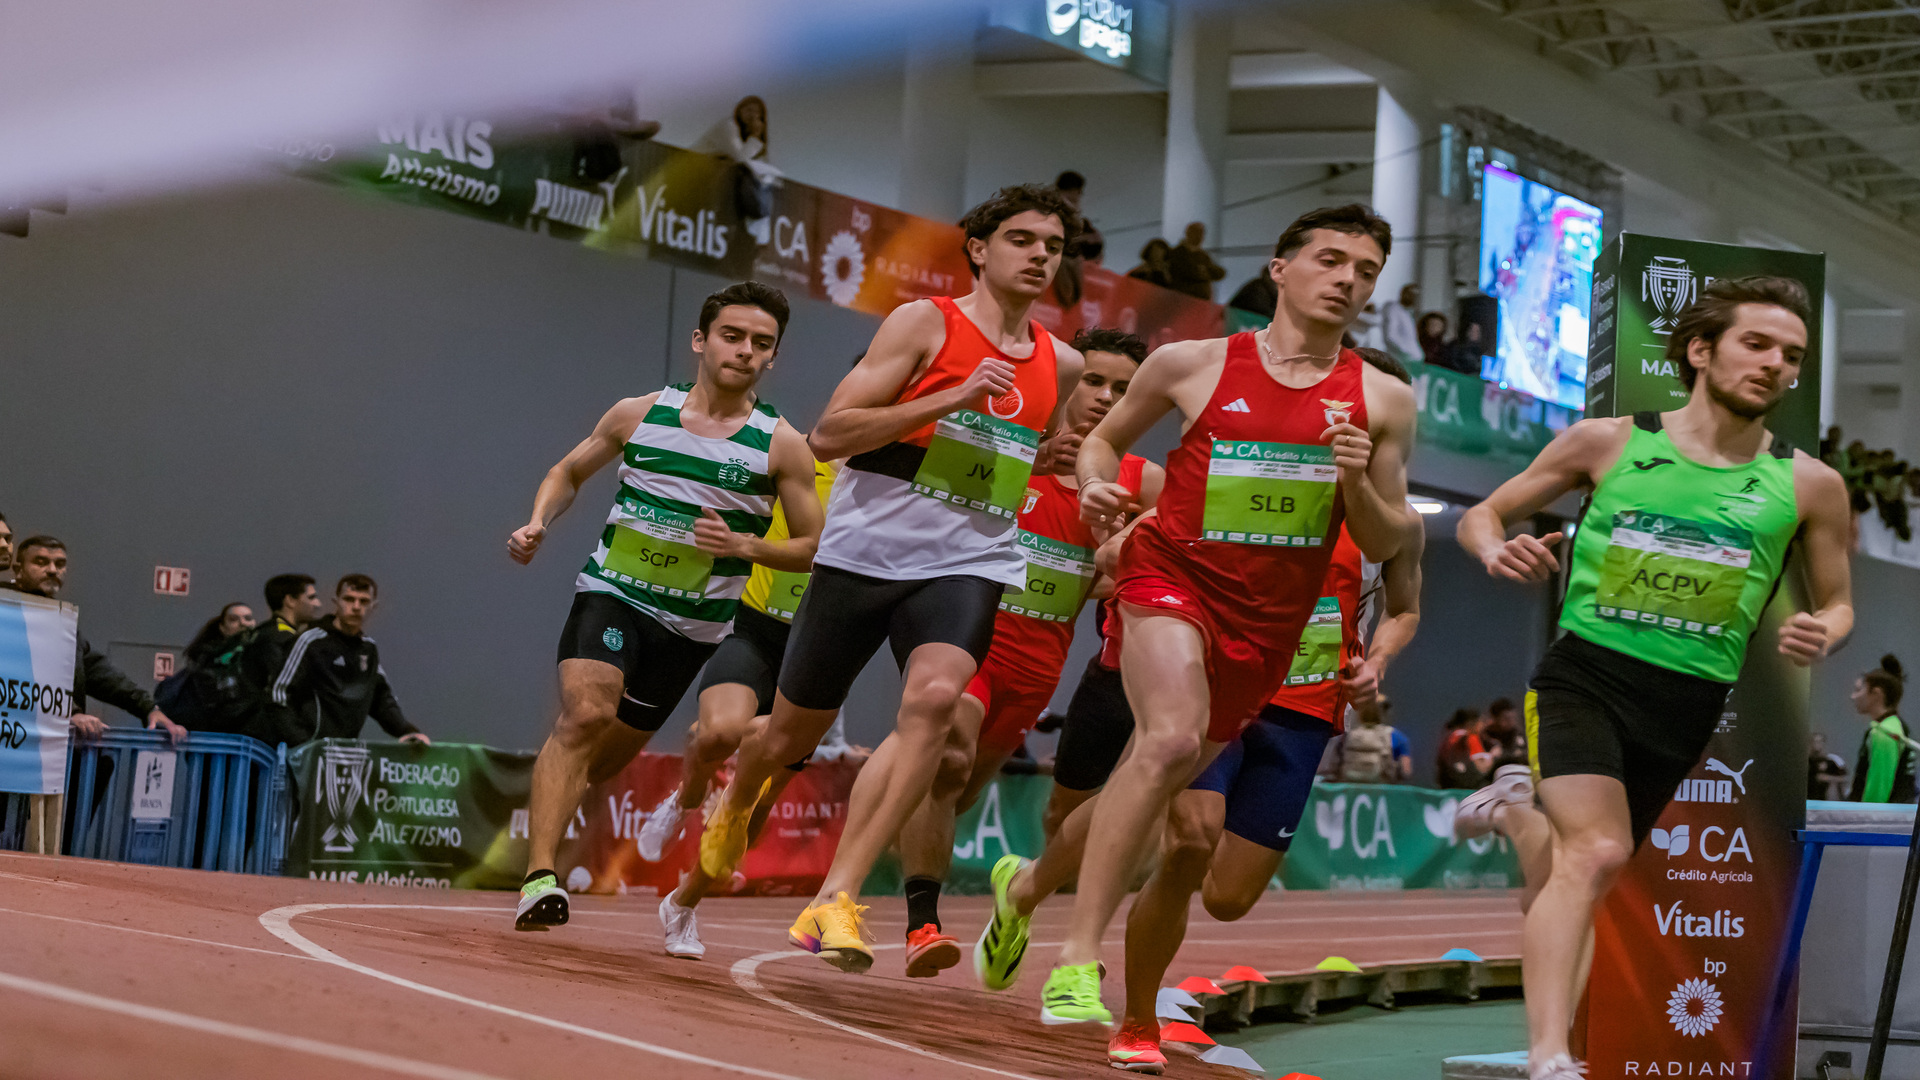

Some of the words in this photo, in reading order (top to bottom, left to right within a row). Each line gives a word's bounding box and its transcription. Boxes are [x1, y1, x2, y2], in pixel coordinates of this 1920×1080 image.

[380, 152, 500, 206] Atletismo
[530, 177, 606, 232] PUMA
[637, 185, 728, 260] Vitalis
[774, 215, 810, 263] CA
[1430, 380, 1464, 427] CA
[962, 411, 982, 428] CA
[984, 423, 1012, 437] Crédito
[728, 457, 750, 466] SCP
[1236, 443, 1262, 458] CA
[1263, 450, 1300, 461] Crédito
[966, 463, 995, 481] JV
[1249, 494, 1295, 514] SLB
[638, 505, 656, 521] CA
[657, 515, 687, 529] Crédito
[1640, 515, 1665, 533] CA
[1020, 532, 1039, 549] CA
[1040, 543, 1068, 557] Crédito
[639, 548, 679, 568] SCP
[1026, 577, 1057, 596] CB
[1631, 568, 1712, 596] ACPV
[379, 757, 460, 788] FEDERAÇÃO
[374, 788, 460, 818] PORTUGUESA
[1674, 778, 1733, 803] UMA
[768, 802, 843, 820] ADIANT
[368, 818, 462, 848] ATLETISMO
[1351, 793, 1397, 859] CA
[1700, 825, 1753, 863] CA
[1666, 868, 1707, 881] Crédito
[1709, 870, 1753, 884] Agrícola
[1653, 900, 1745, 938] Vitalis
[1704, 957, 1727, 977] bp
[1625, 1061, 1753, 1076] RADIANT
